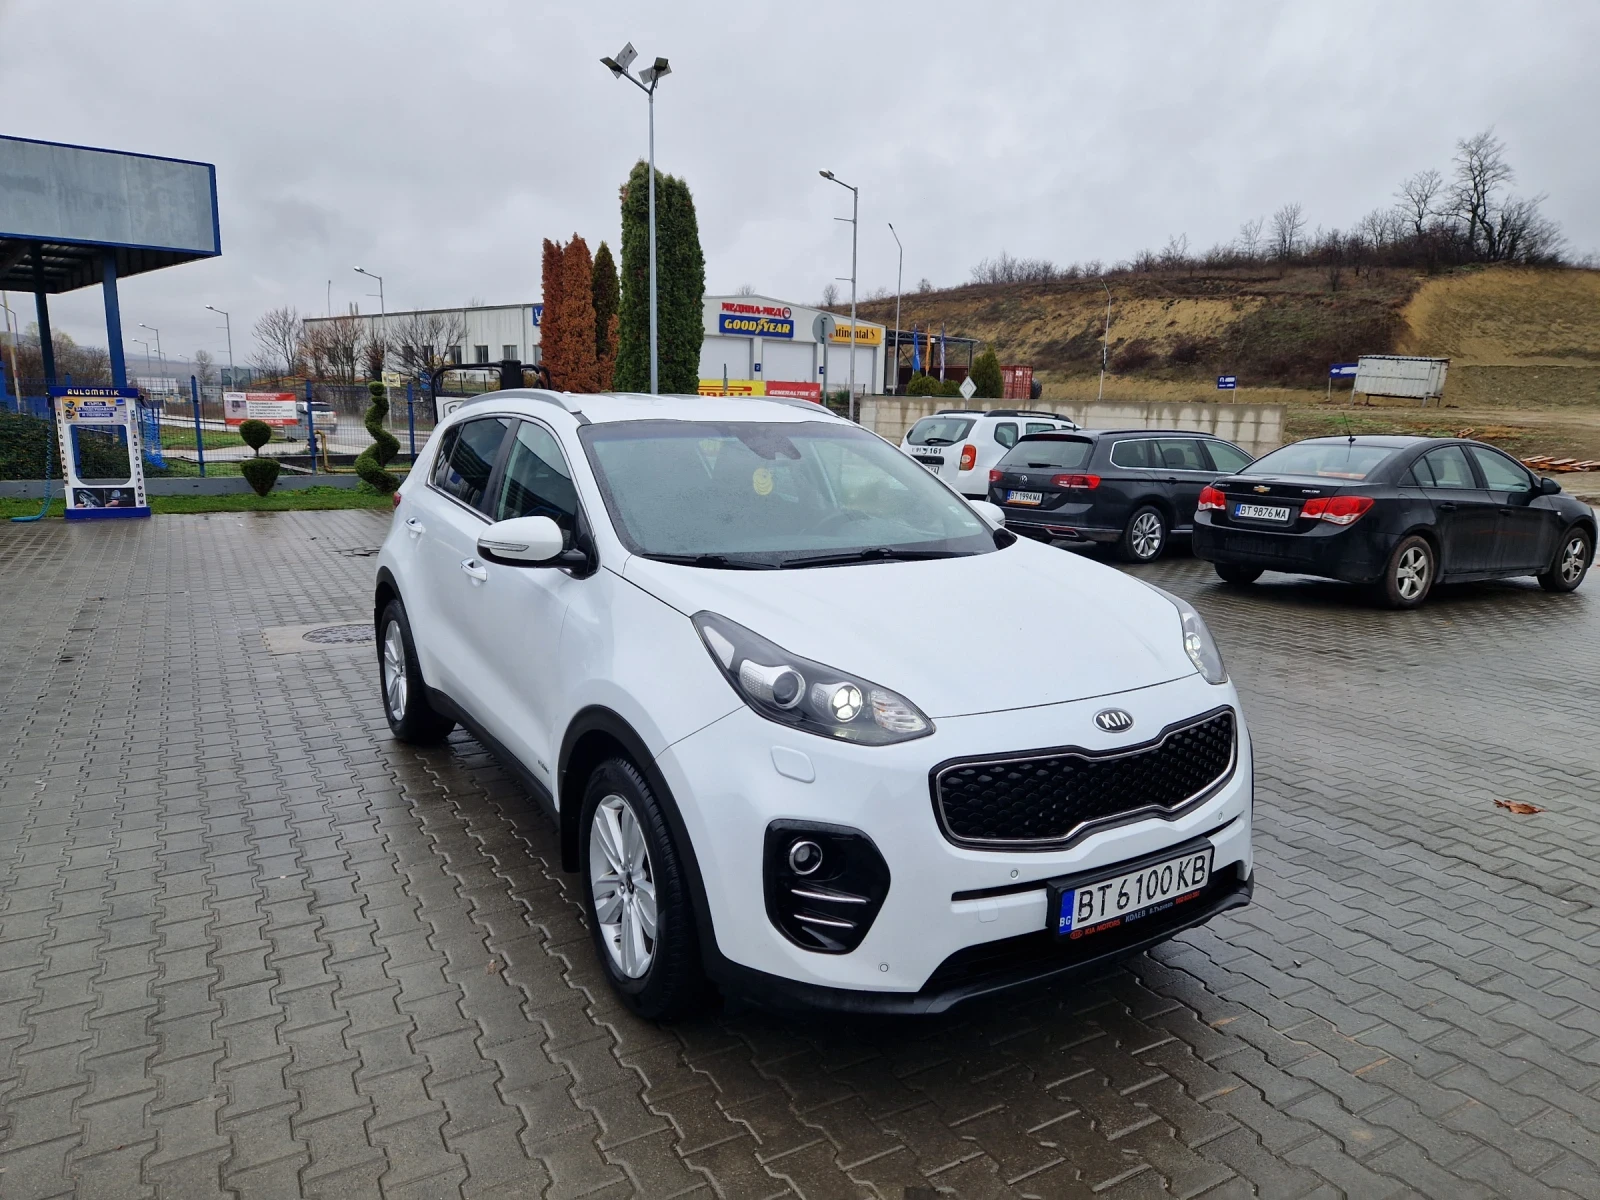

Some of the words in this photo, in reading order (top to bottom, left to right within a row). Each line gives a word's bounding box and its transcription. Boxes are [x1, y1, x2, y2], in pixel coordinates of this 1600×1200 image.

[67, 388, 120, 396] RULOMATIK
[1098, 711, 1132, 729] KIA
[1059, 916, 1072, 927] BG
[1085, 927, 1096, 935] KIA
[1096, 919, 1121, 932] MOTORS
